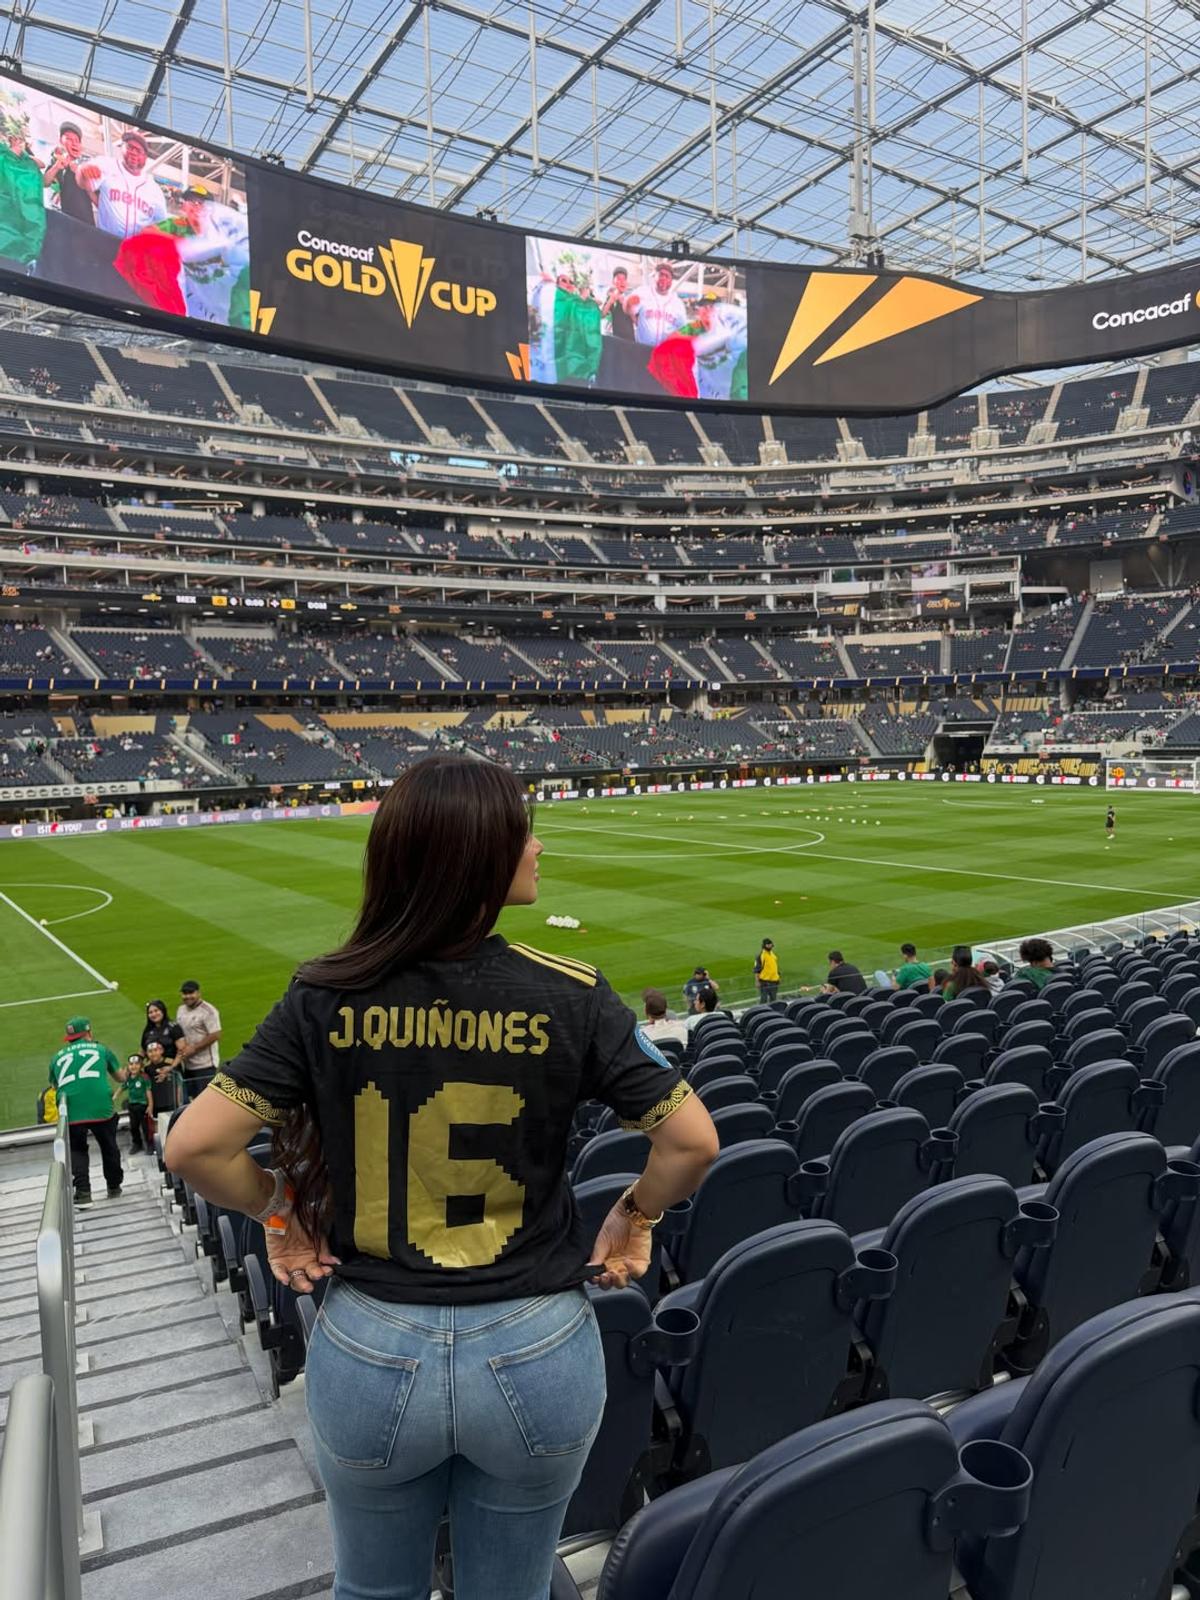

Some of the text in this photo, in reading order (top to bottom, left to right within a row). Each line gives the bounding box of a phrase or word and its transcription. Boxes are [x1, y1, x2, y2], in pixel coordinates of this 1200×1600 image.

[297, 230, 375, 263] Concacaf
[286, 248, 497, 317] GOLD CUP
[1092, 292, 1192, 330] Concacaf
[328, 998, 552, 1055] J.QUIÑONES
[56, 1048, 101, 1088] 22
[353, 1080, 526, 1268] 16
